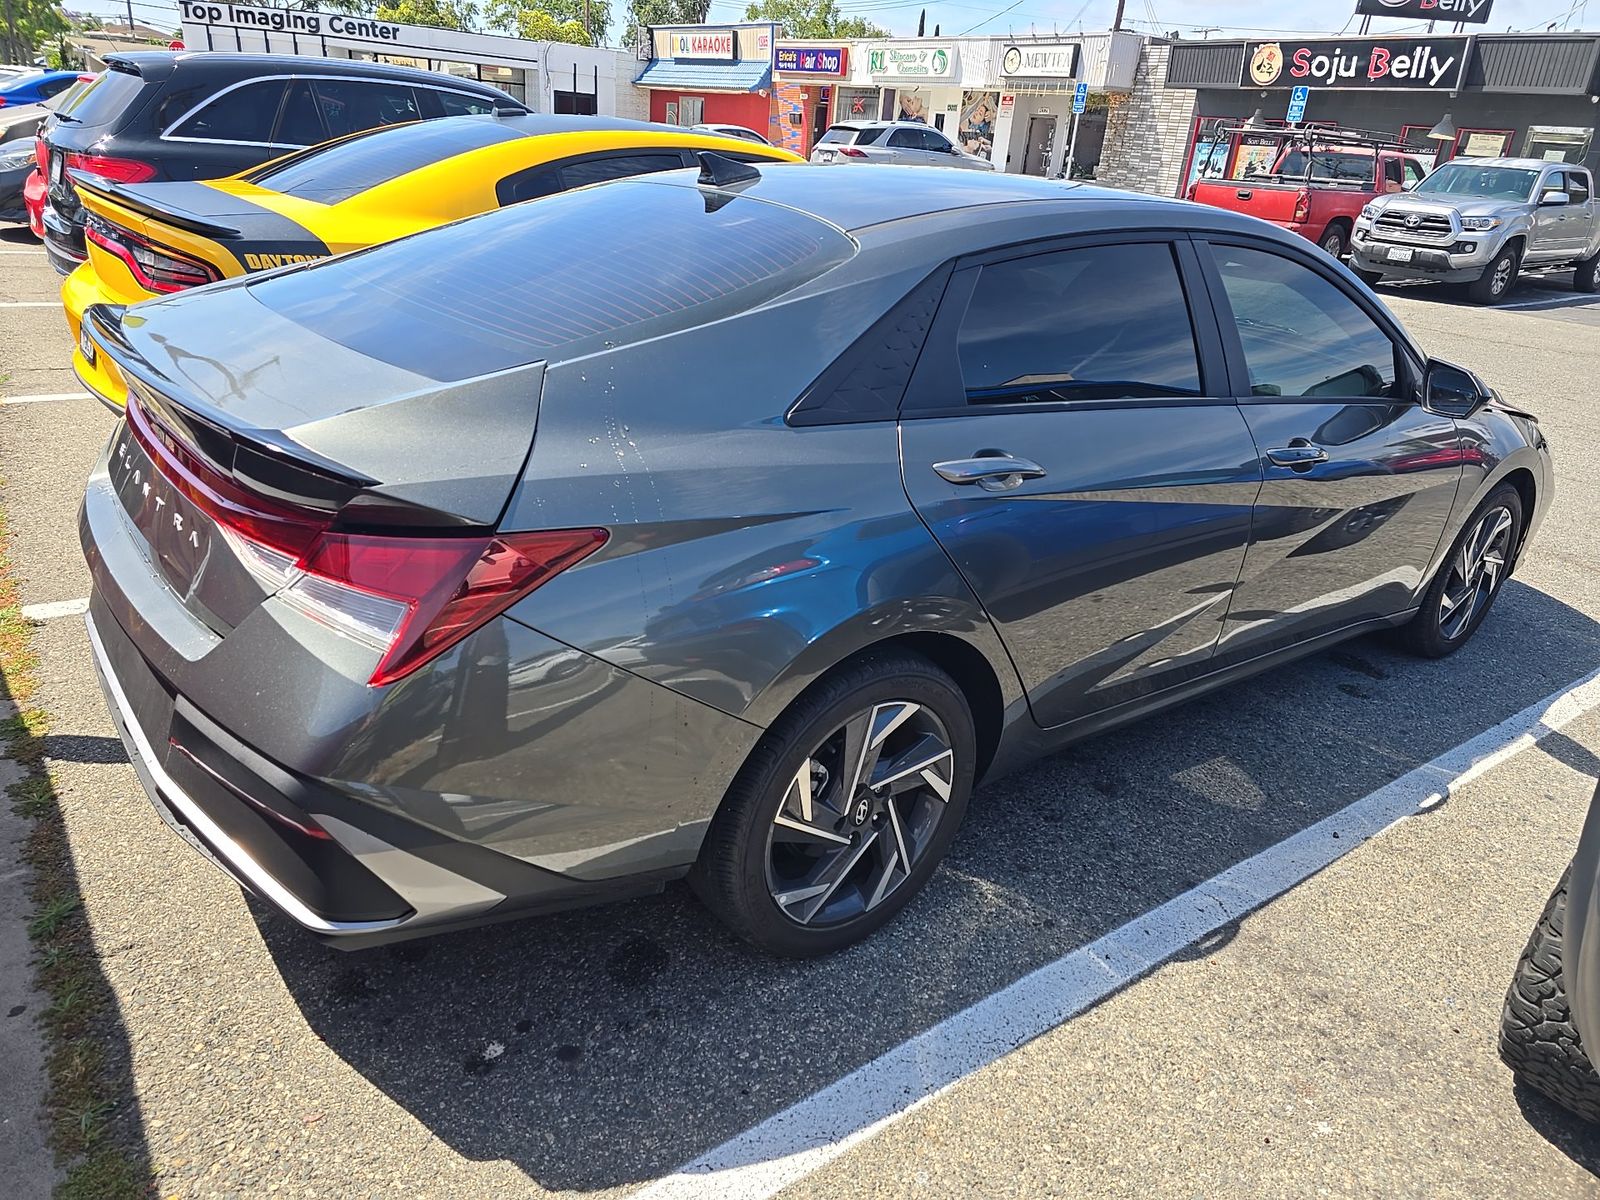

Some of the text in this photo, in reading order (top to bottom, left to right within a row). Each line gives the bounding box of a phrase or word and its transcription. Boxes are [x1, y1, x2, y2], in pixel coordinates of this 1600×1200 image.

[182, 1, 400, 40] Top Imaging Center
[691, 36, 731, 54] KARAOKE
[800, 52, 816, 69] Hair
[817, 53, 838, 71] Shop
[1290, 47, 1454, 86] Soju Belly
[244, 254, 327, 270] DAYTO
[118, 443, 199, 547] ELANTRA
